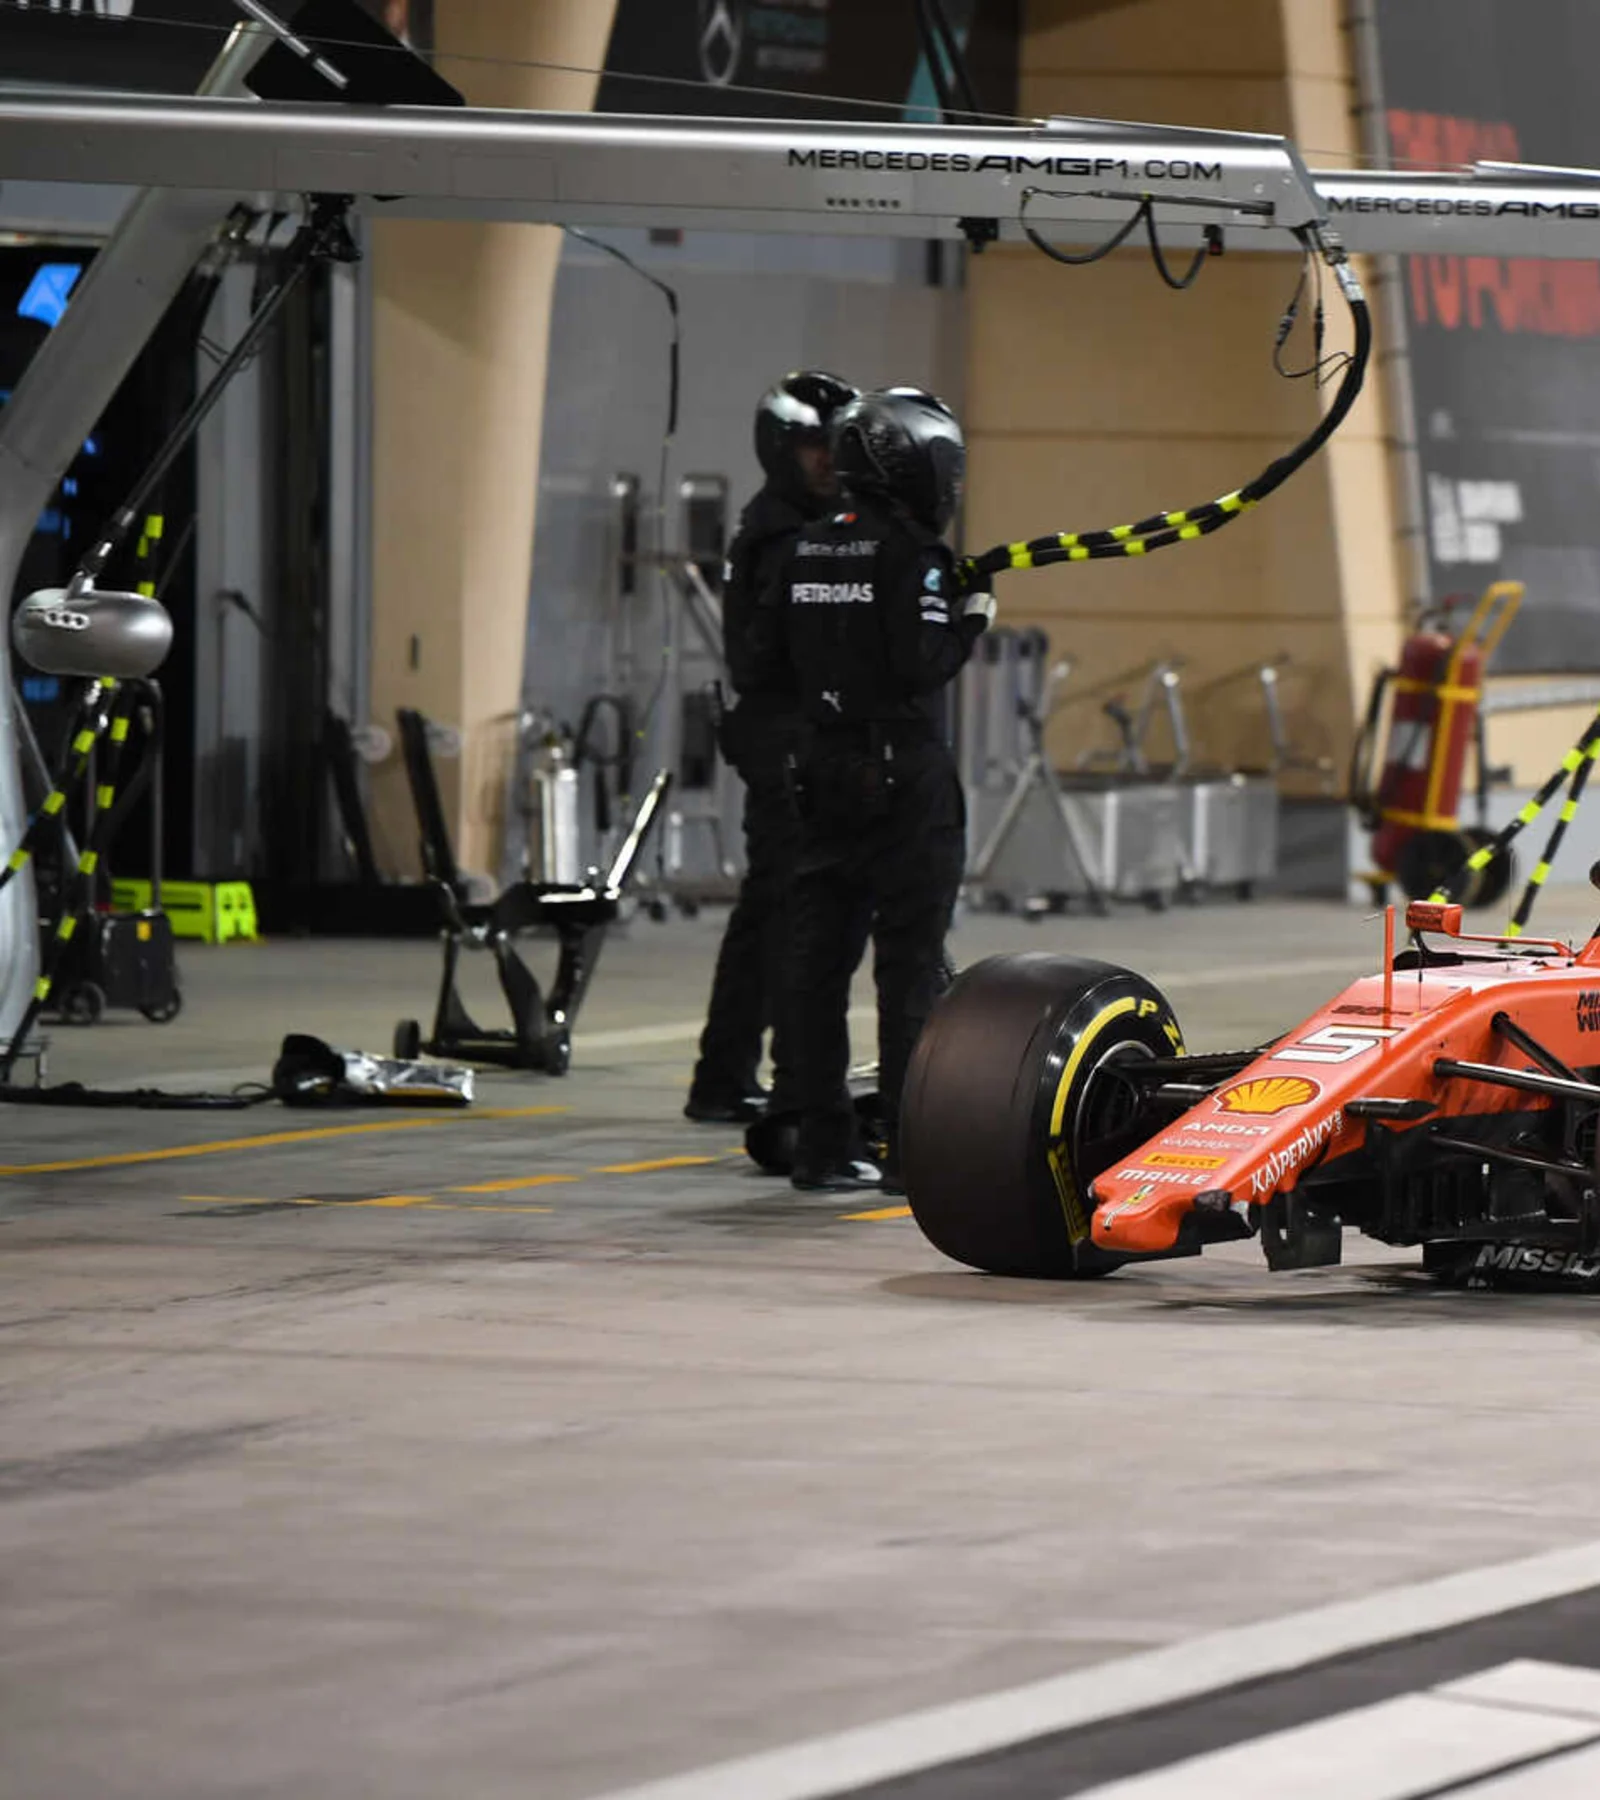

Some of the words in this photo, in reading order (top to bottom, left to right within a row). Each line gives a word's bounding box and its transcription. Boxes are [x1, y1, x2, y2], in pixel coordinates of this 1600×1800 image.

[787, 148, 1224, 182] MERCEDESAMGF1.COM
[1268, 1023, 1407, 1064] 5
[1114, 1168, 1213, 1185] MAHLE
